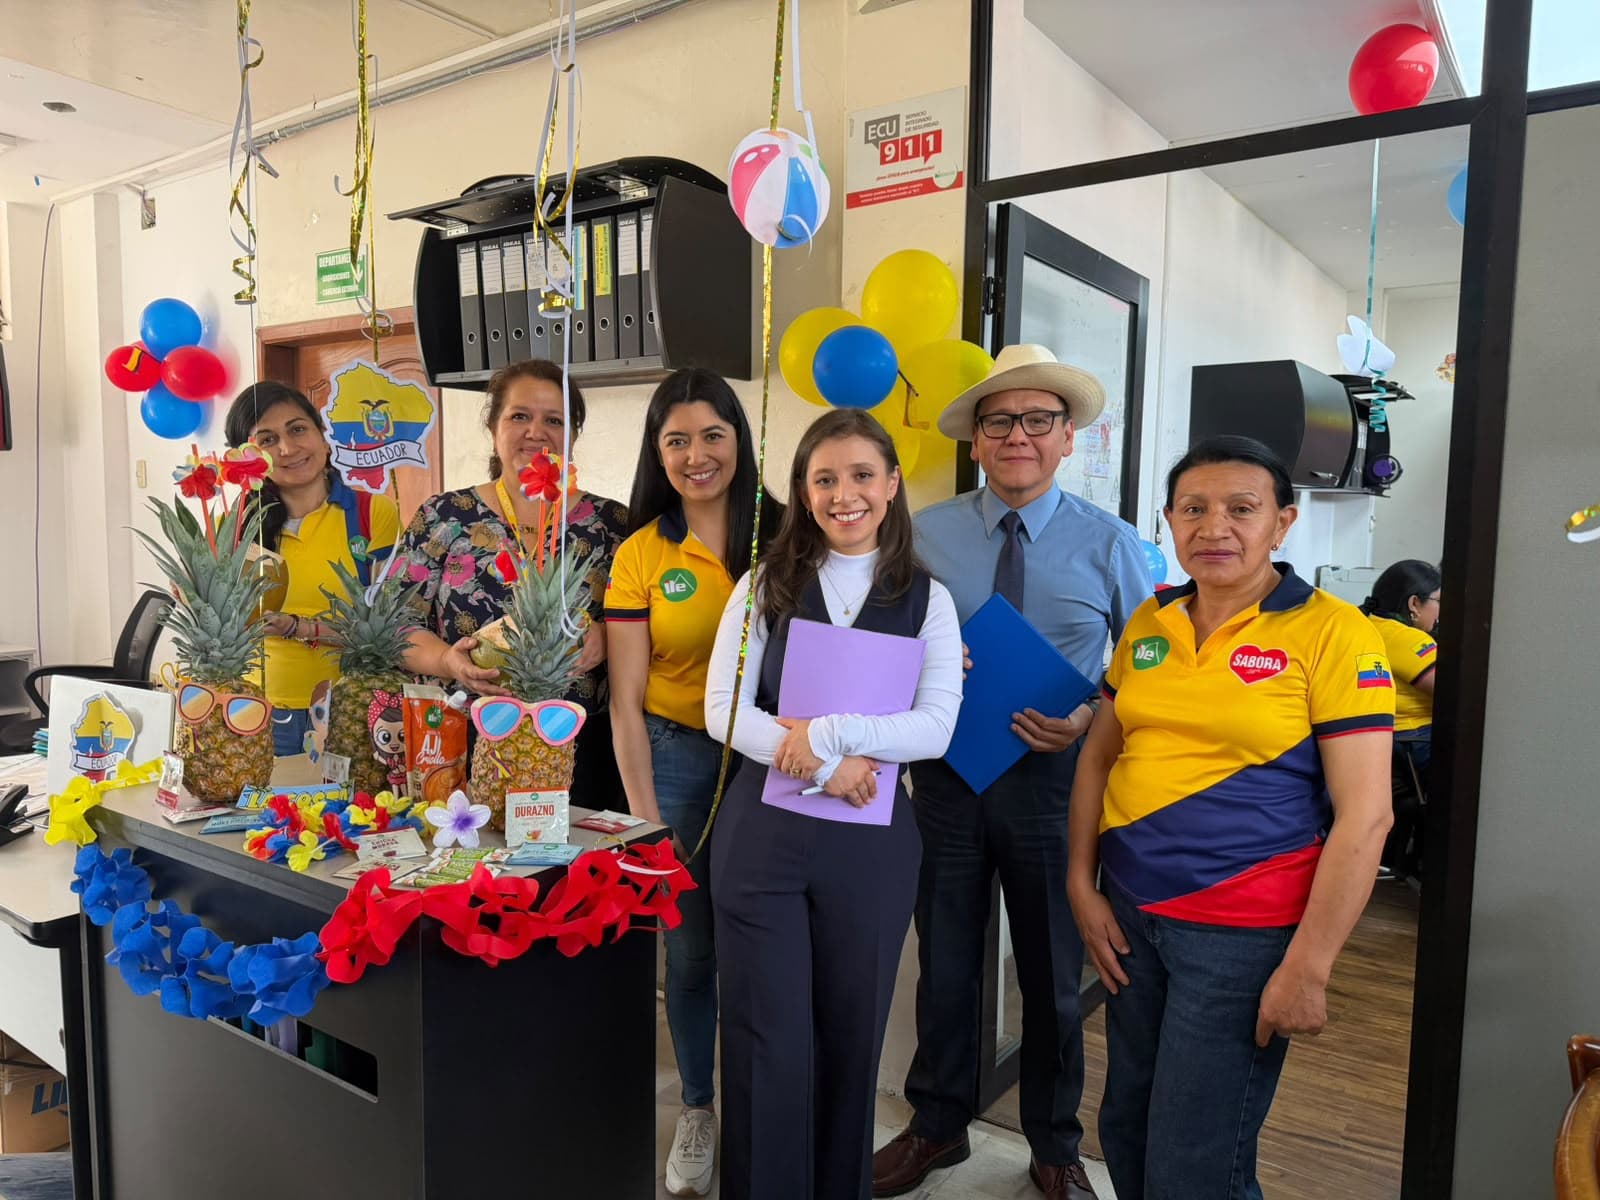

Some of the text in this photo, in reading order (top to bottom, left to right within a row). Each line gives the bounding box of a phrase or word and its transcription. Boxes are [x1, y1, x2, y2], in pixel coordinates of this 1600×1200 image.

[868, 119, 896, 140] ECU
[884, 134, 935, 162] 911
[356, 443, 407, 466] ECUADOR
[1232, 653, 1282, 671] SABORA
[515, 804, 555, 818] DURAZNO
